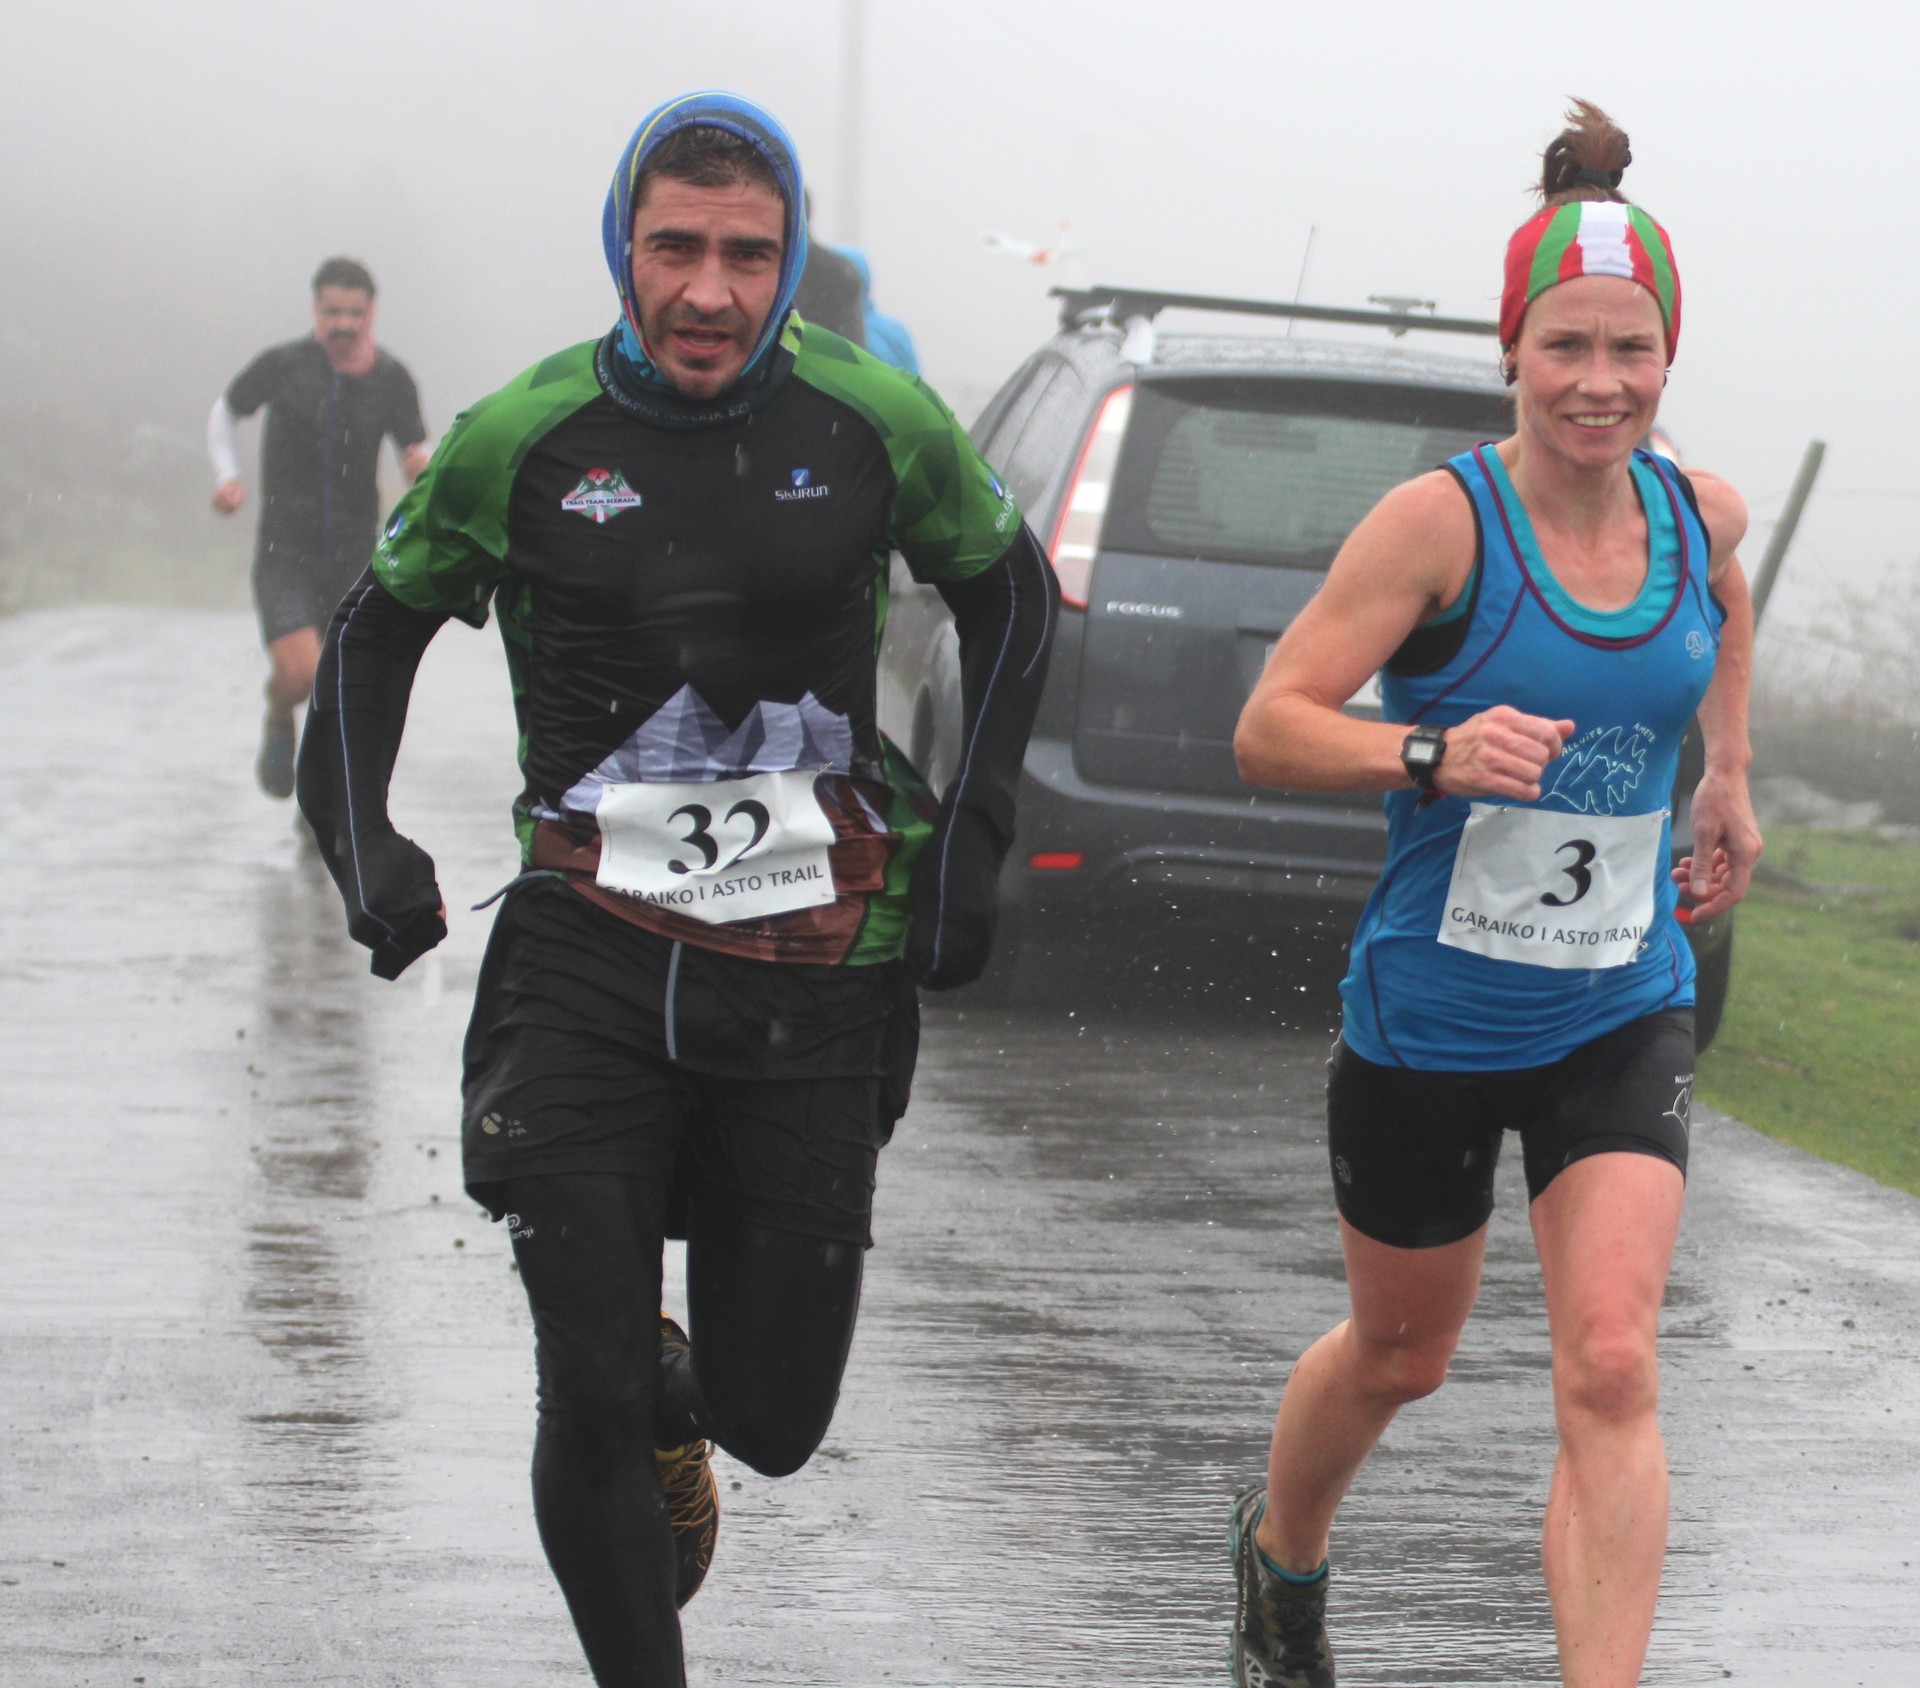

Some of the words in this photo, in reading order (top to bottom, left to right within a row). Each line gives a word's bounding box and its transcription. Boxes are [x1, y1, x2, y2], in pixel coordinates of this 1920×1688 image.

[1106, 601, 1183, 620] FOCUS
[666, 799, 770, 875] 32
[712, 875, 762, 898] ASTO
[768, 864, 824, 887] TRAIL
[1539, 839, 1596, 907] 3
[1451, 907, 1535, 939] GARAIKO
[1552, 928, 1599, 946] ASTO
